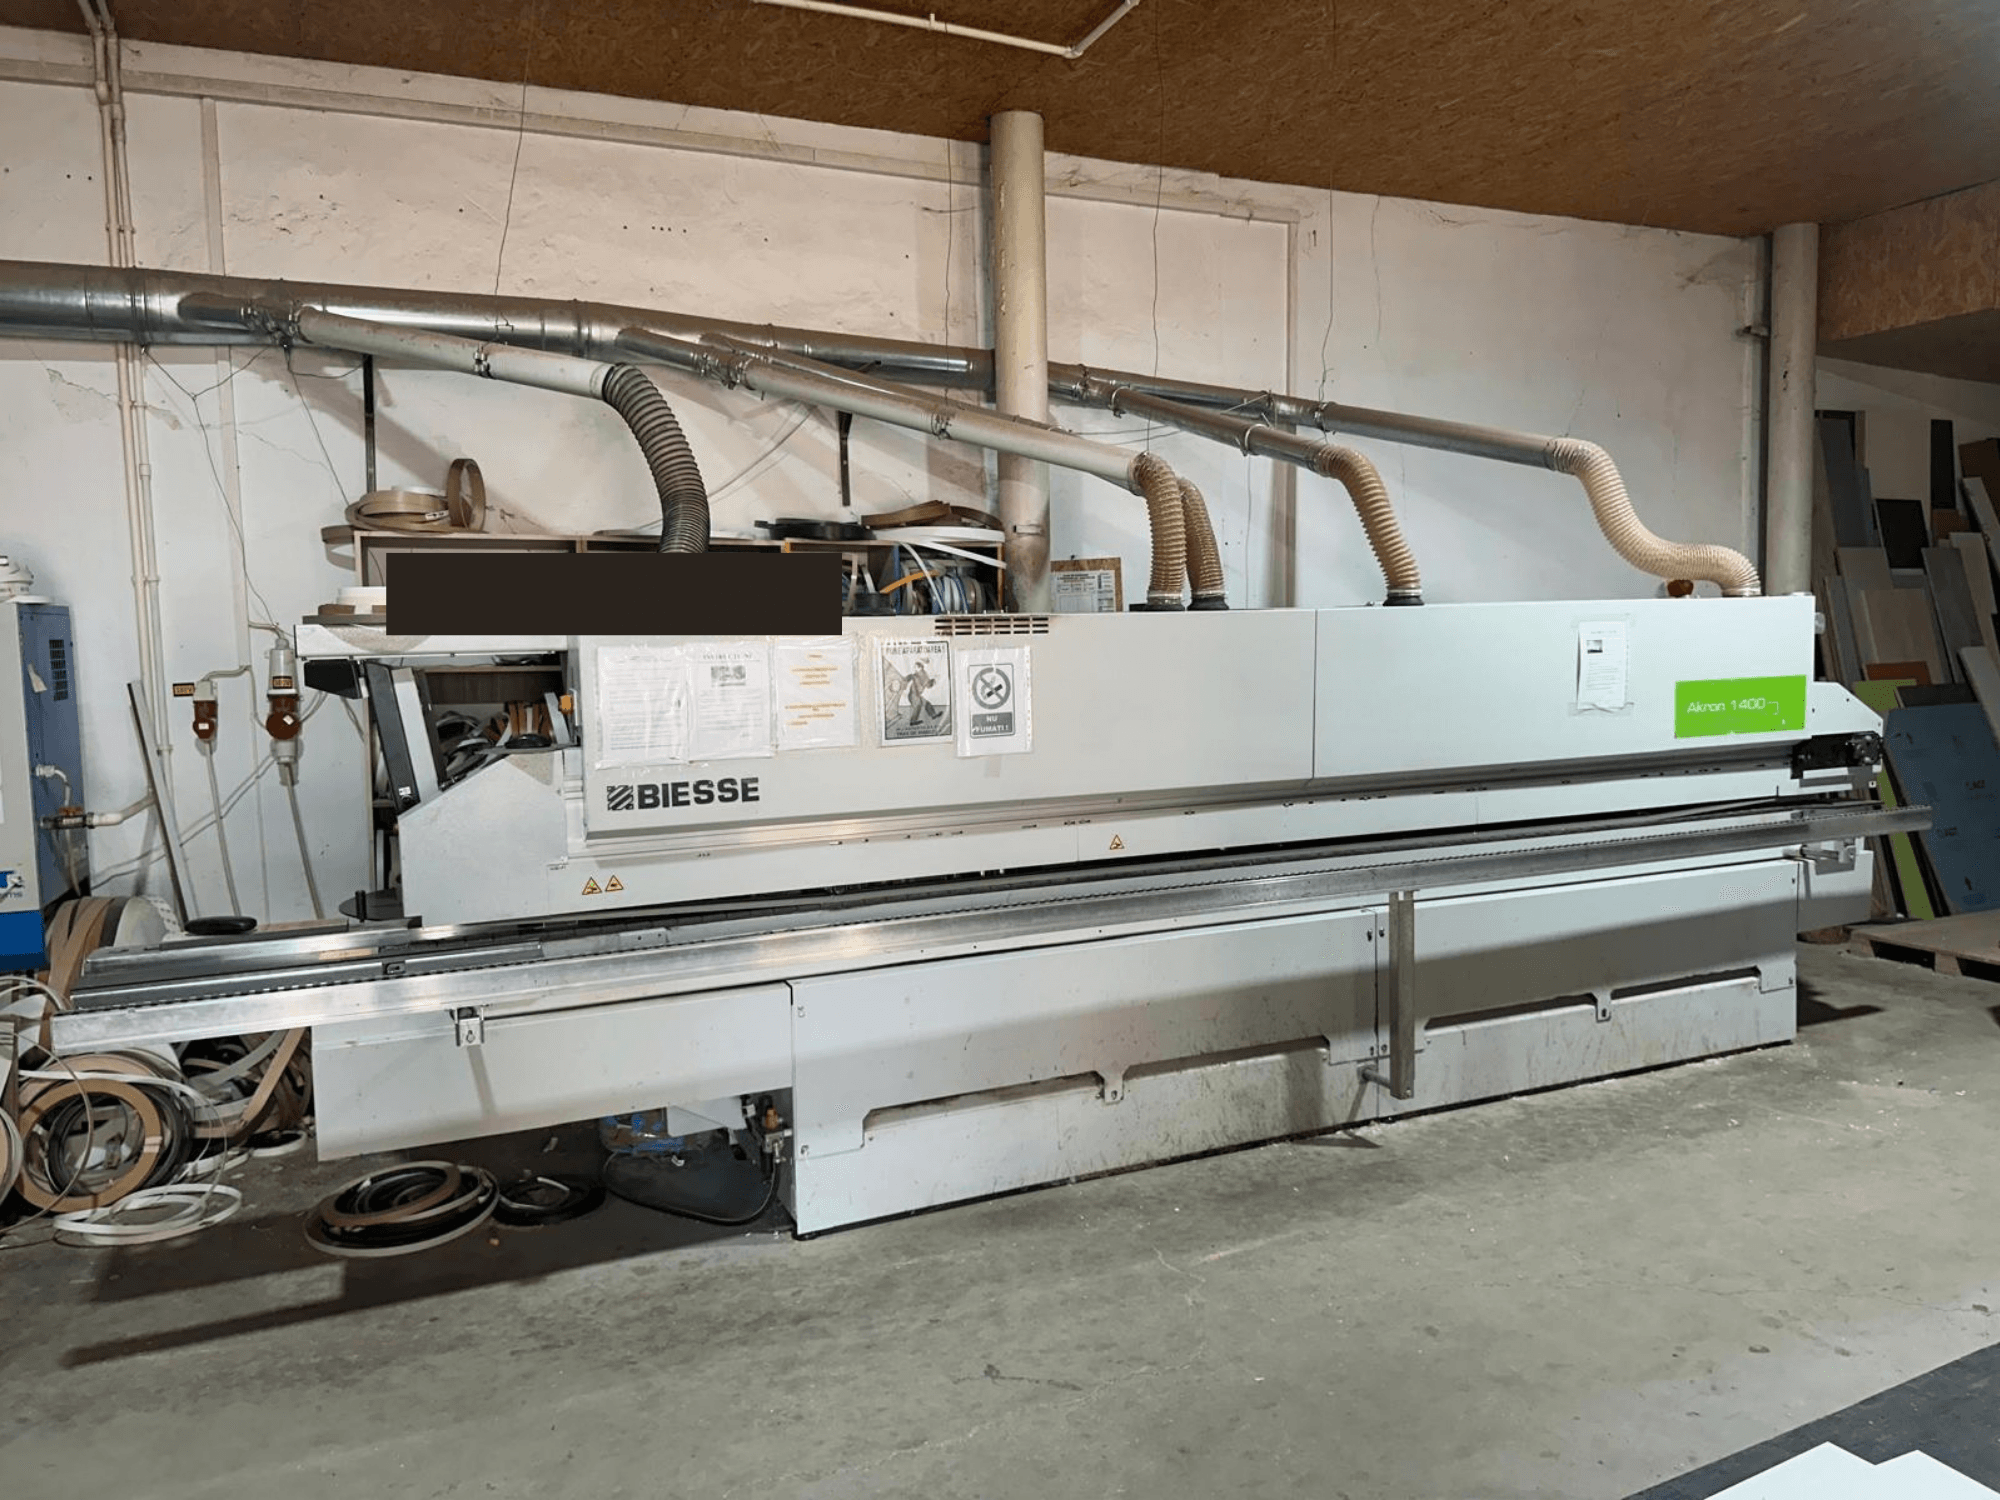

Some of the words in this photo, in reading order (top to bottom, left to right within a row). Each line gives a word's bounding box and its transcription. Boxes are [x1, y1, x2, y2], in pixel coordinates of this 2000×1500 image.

[1687, 701, 1726, 713] Akron
[1731, 697, 1766, 711] 1400
[986, 714, 998, 722] NU
[637, 776, 760, 810] BIESSE
